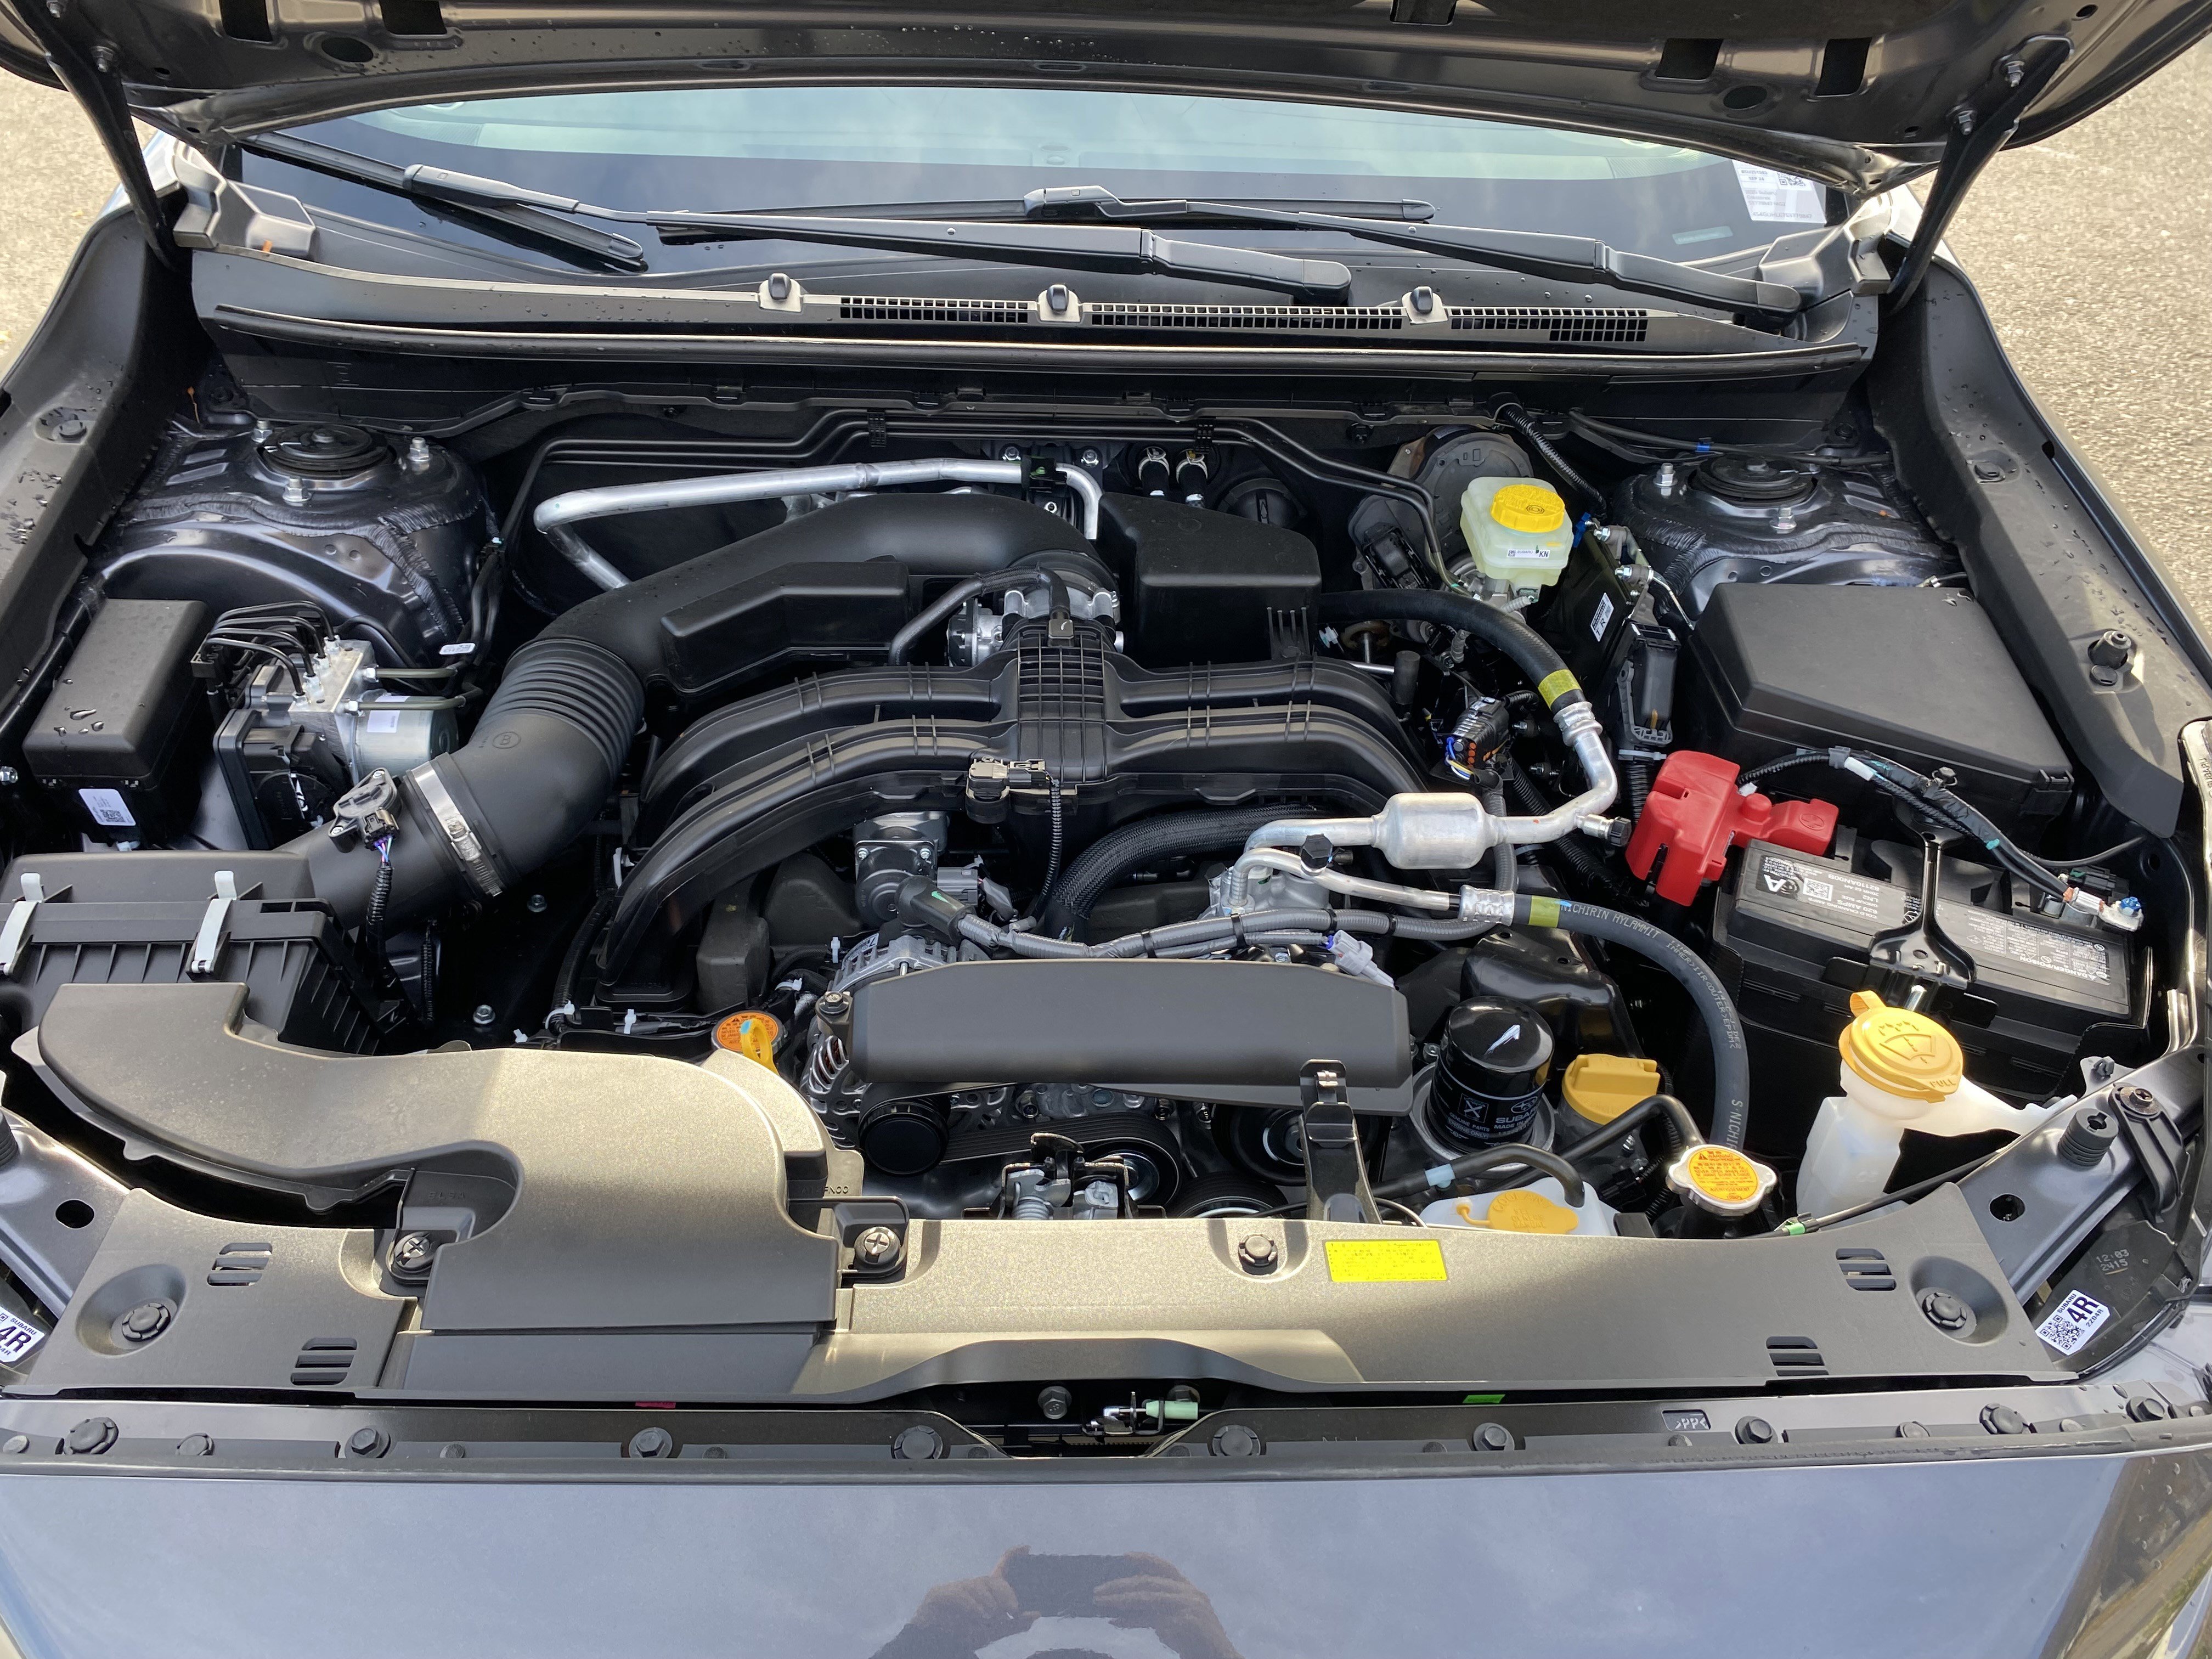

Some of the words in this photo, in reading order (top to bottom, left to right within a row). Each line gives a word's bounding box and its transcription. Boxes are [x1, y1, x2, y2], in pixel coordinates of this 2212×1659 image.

[1828, 873, 1880, 891] 82110AN00B
[1837, 899, 1861, 910] AMPS
[1863, 894, 1878, 903] LN2
[1861, 910, 1877, 919] COLD
[1863, 906, 1878, 915] 620
[1561, 902, 1610, 920] NICHIRIN
[1612, 913, 1662, 939] HYLAMMIT
[2019, 956, 2089, 979] DANGER/POISON
[1472, 1124, 1490, 1132] PARTS
[2096, 1249, 2130, 1263] 12:03
[2100, 1258, 2129, 1272] 2415
[2057, 1293, 2077, 1313] SUBARU
[2066, 1296, 2100, 1323] 4R
[10, 1317, 38, 1335] SUBARU
[0, 1325, 32, 1353] 4R
